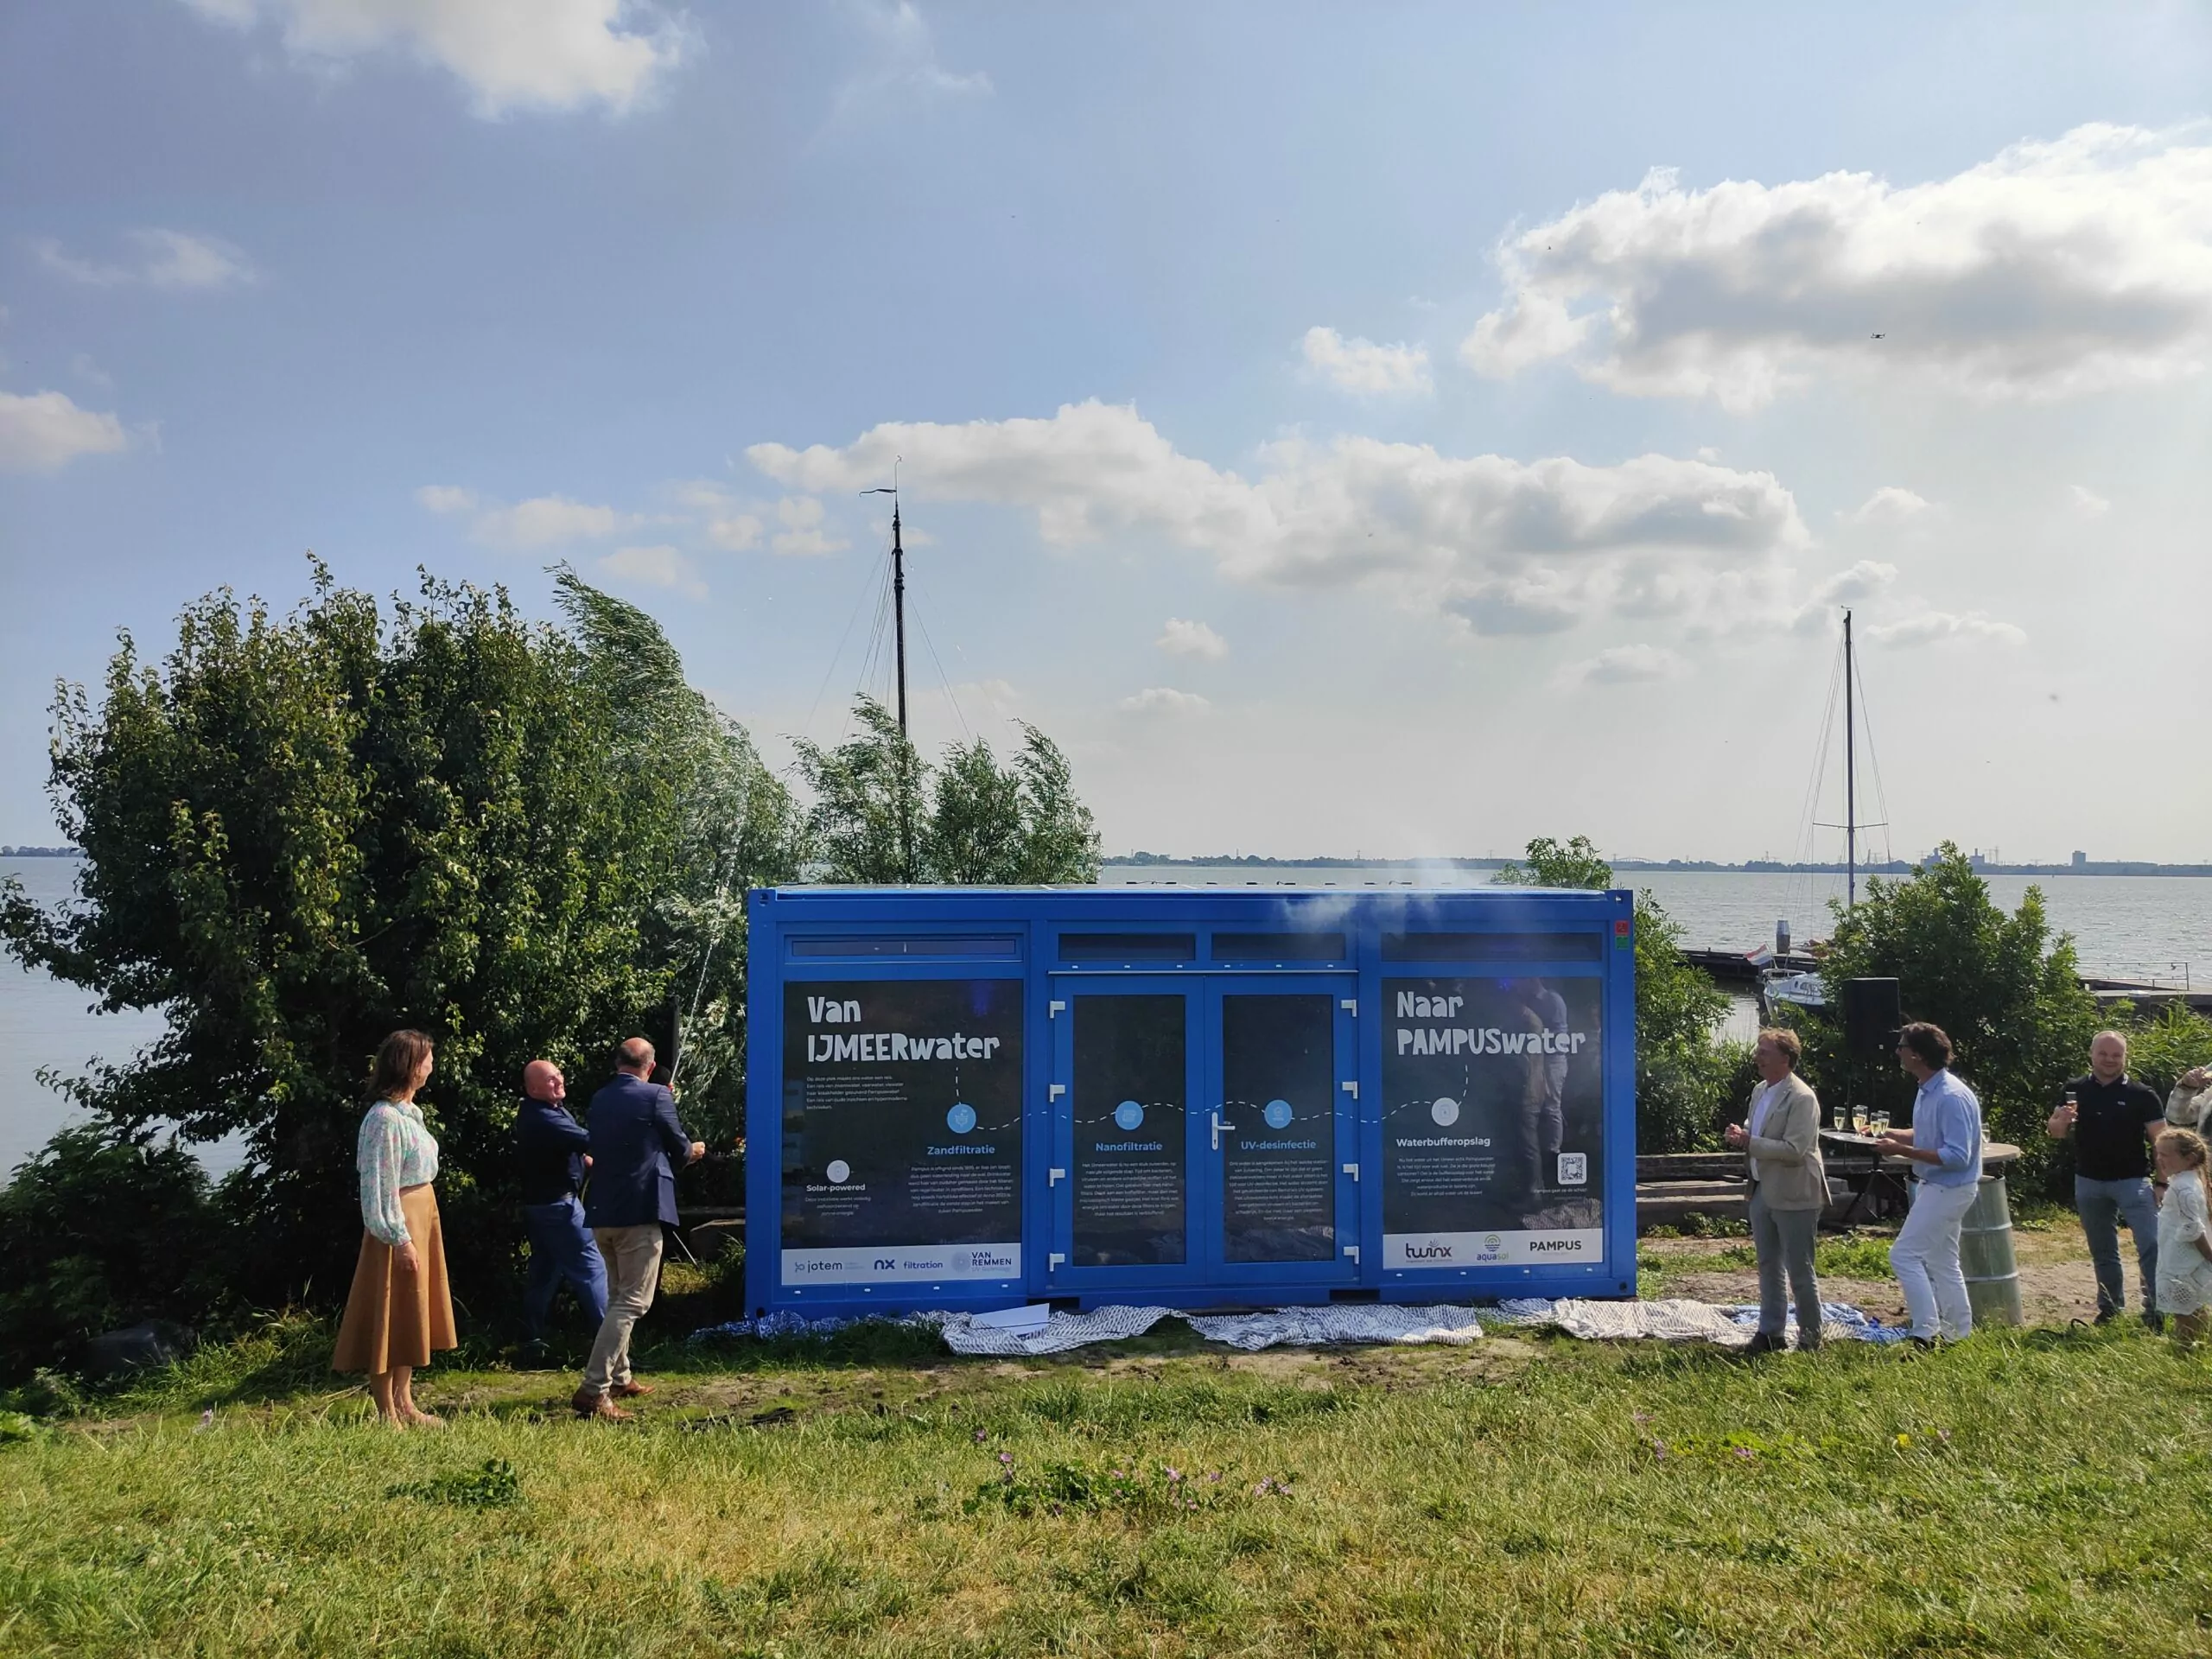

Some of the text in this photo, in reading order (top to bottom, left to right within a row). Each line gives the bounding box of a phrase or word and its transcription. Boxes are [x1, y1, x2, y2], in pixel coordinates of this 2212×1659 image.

[807, 996, 861, 1023] Van
[1396, 991, 1464, 1018] Naar
[1396, 1027, 1586, 1055] PAMPUSwater
[807, 1032, 1001, 1062] IJMEERwater
[1096, 1141, 1163, 1152] Nanofiltratie
[1241, 1139, 1317, 1149] UV-desinfectie
[1396, 1136, 1491, 1147] Waterbufferopslag
[927, 1145, 995, 1155] Zandfiltratie
[806, 1184, 866, 1192] Solar-powered
[1406, 1243, 1452, 1258] twinx
[1529, 1240, 1582, 1251] PAMPUS
[1477, 1252, 1509, 1262] aquasol
[807, 1260, 842, 1273] jotem
[903, 1261, 944, 1269] filtration
